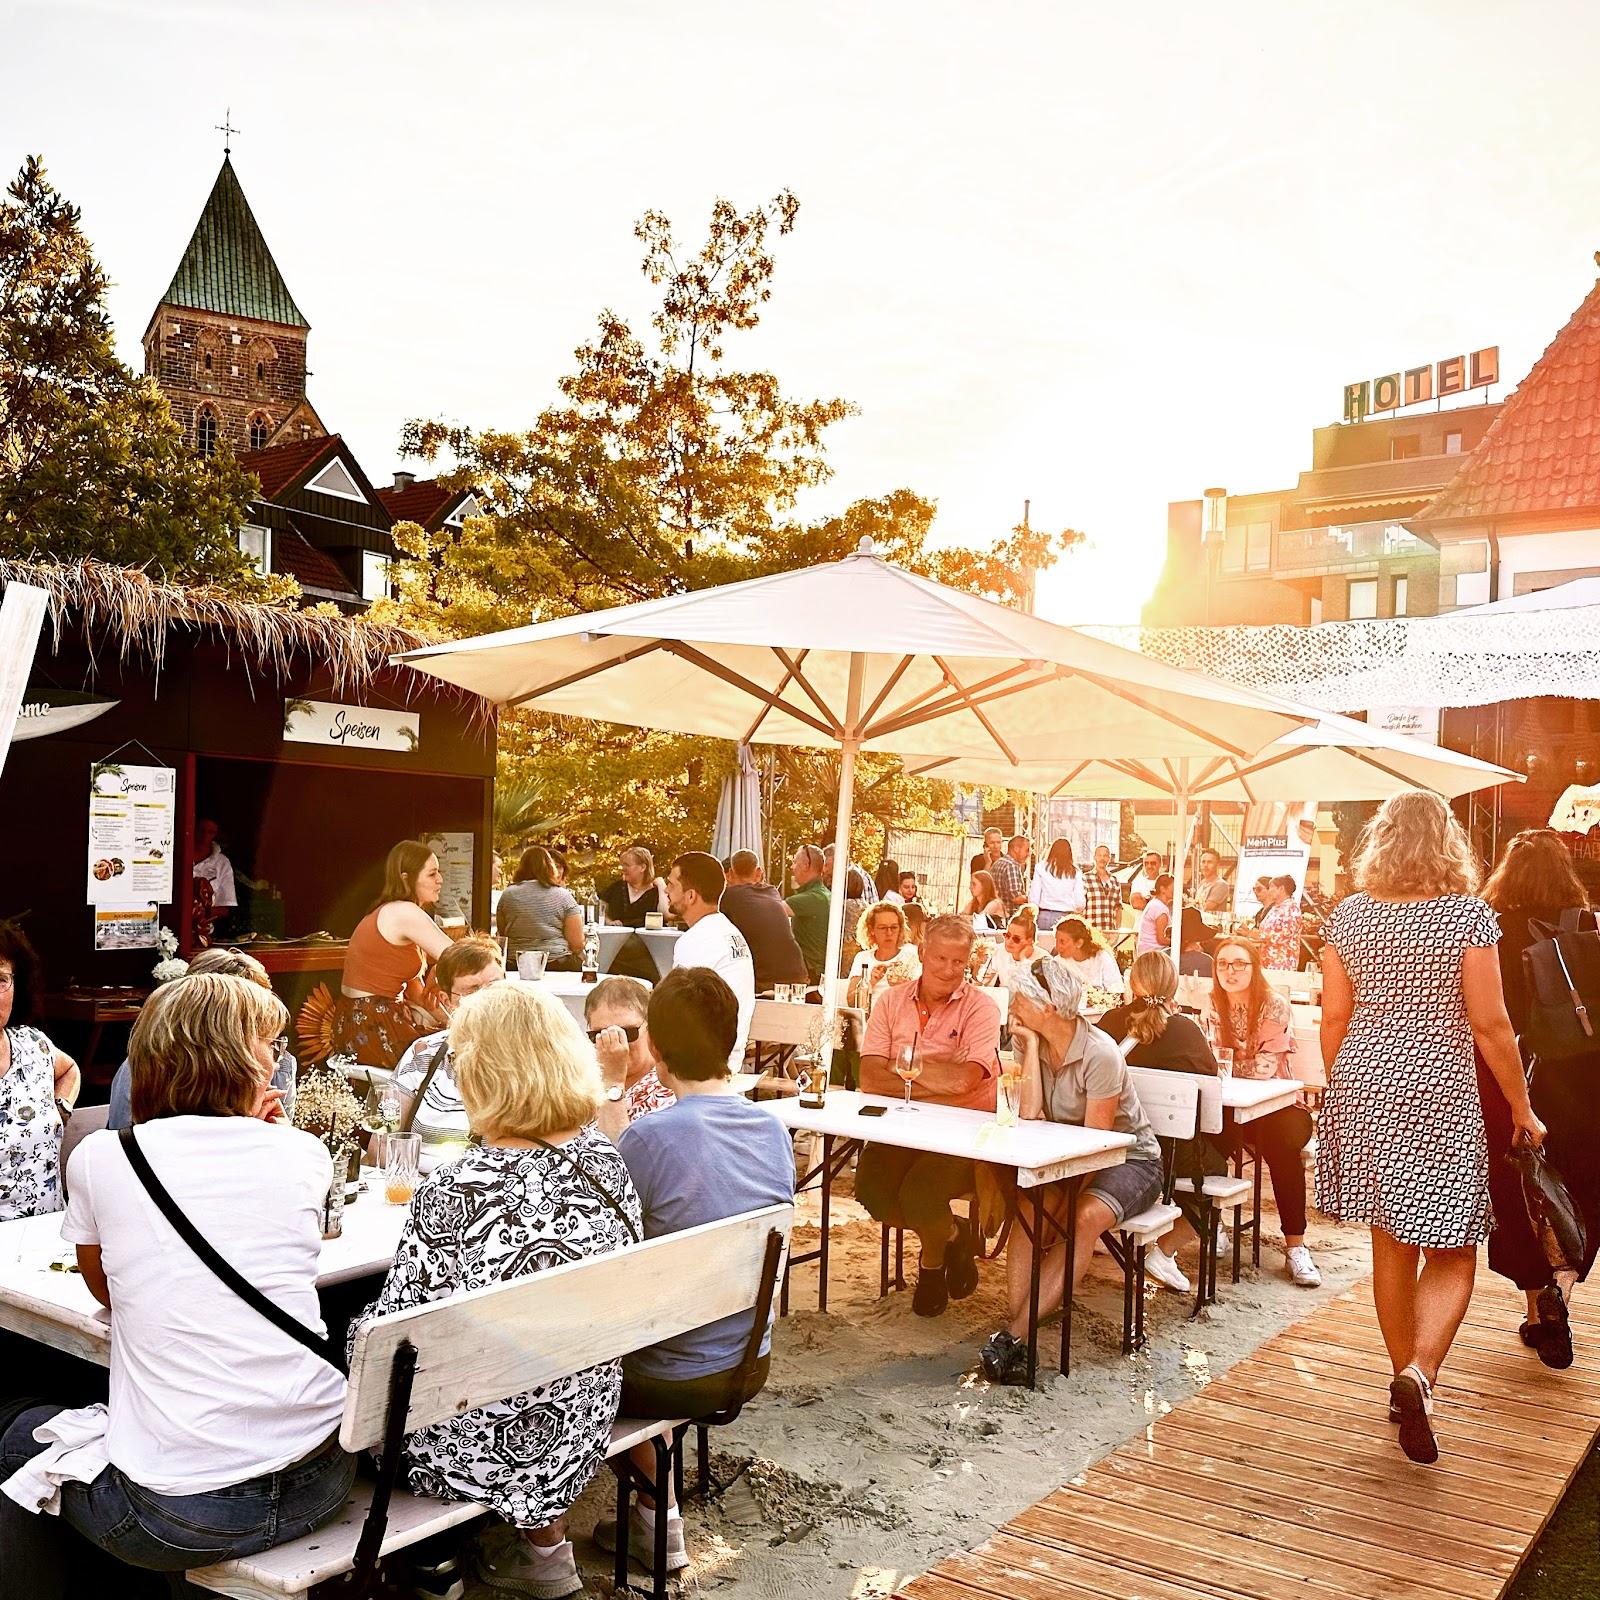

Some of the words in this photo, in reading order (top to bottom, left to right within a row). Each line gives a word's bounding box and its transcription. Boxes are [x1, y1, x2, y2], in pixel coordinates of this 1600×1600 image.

[1344, 347, 1498, 420] HOTEL
[329, 710, 380, 744] Speisen
[120, 778, 148, 794] Speisen
